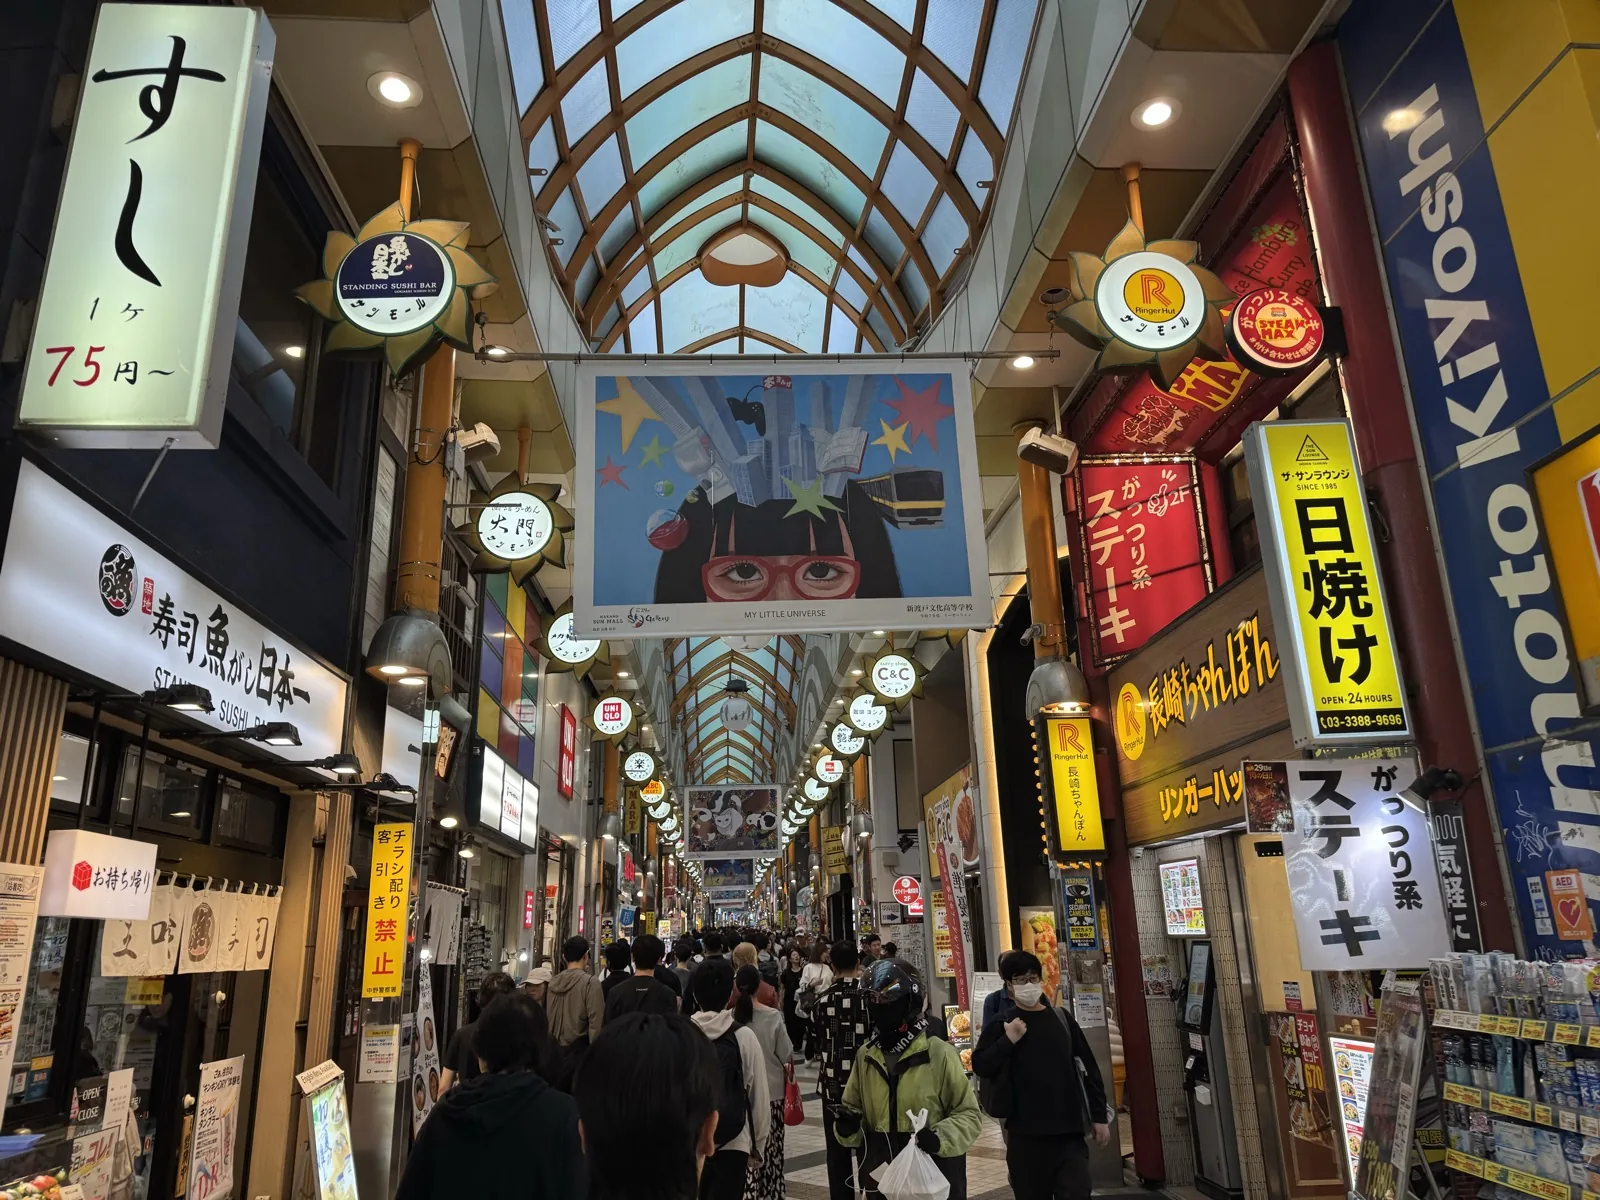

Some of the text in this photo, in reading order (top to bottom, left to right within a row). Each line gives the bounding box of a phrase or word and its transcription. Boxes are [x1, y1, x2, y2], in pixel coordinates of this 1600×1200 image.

[92, 36, 226, 287] すし
[1242, 219, 1300, 279] Hamburg
[350, 298, 426, 320] サンモール
[1135, 307, 1176, 317] Ringer Hut
[1120, 315, 1190, 336] サンモール
[1258, 318, 1307, 331] STEAK
[1262, 329, 1296, 341] MAX
[1281, 469, 1350, 482] ザ・サンラウンジ
[1322, 482, 1338, 490] 1985
[1169, 485, 1190, 507] 2F
[489, 514, 536, 538] 大門
[1121, 475, 1152, 590] がっつり系
[1086, 489, 1136, 644] ステーキ
[142, 579, 154, 614] 築地
[1295, 498, 1379, 686] 日焼け
[760, 611, 785, 619] LITTLE
[786, 609, 827, 618] UNIVERSE
[1148, 614, 1281, 738] 長崎ちゃんぽん
[604, 703, 619, 712] UNI
[1347, 692, 1363, 704] 24
[1364, 694, 1393, 703] HOURS
[219, 699, 250, 732] SUSHI
[604, 712, 620, 720] QLO
[1327, 713, 1402, 729] 03-3388-9696
[563, 716, 575, 754] UNI
[1054, 753, 1077, 762] Ringer
[562, 756, 573, 791] QLO
[1067, 766, 1087, 842] 長崎ちゃんぽん
[1159, 768, 1244, 822] リンガーハッ
[628, 790, 638, 830] MART
[1370, 765, 1424, 911] がっつり系
[374, 830, 391, 910] 客引き
[389, 829, 406, 909] チラシ配り
[1298, 770, 1382, 958] ステーキ
[93, 867, 151, 896] お持ち帰り
[1555, 876, 1573, 887] AED
[372, 918, 398, 975] 禁止
[82, 1087, 101, 1101] OPEN
[77, 1106, 99, 1122] CLOSE
